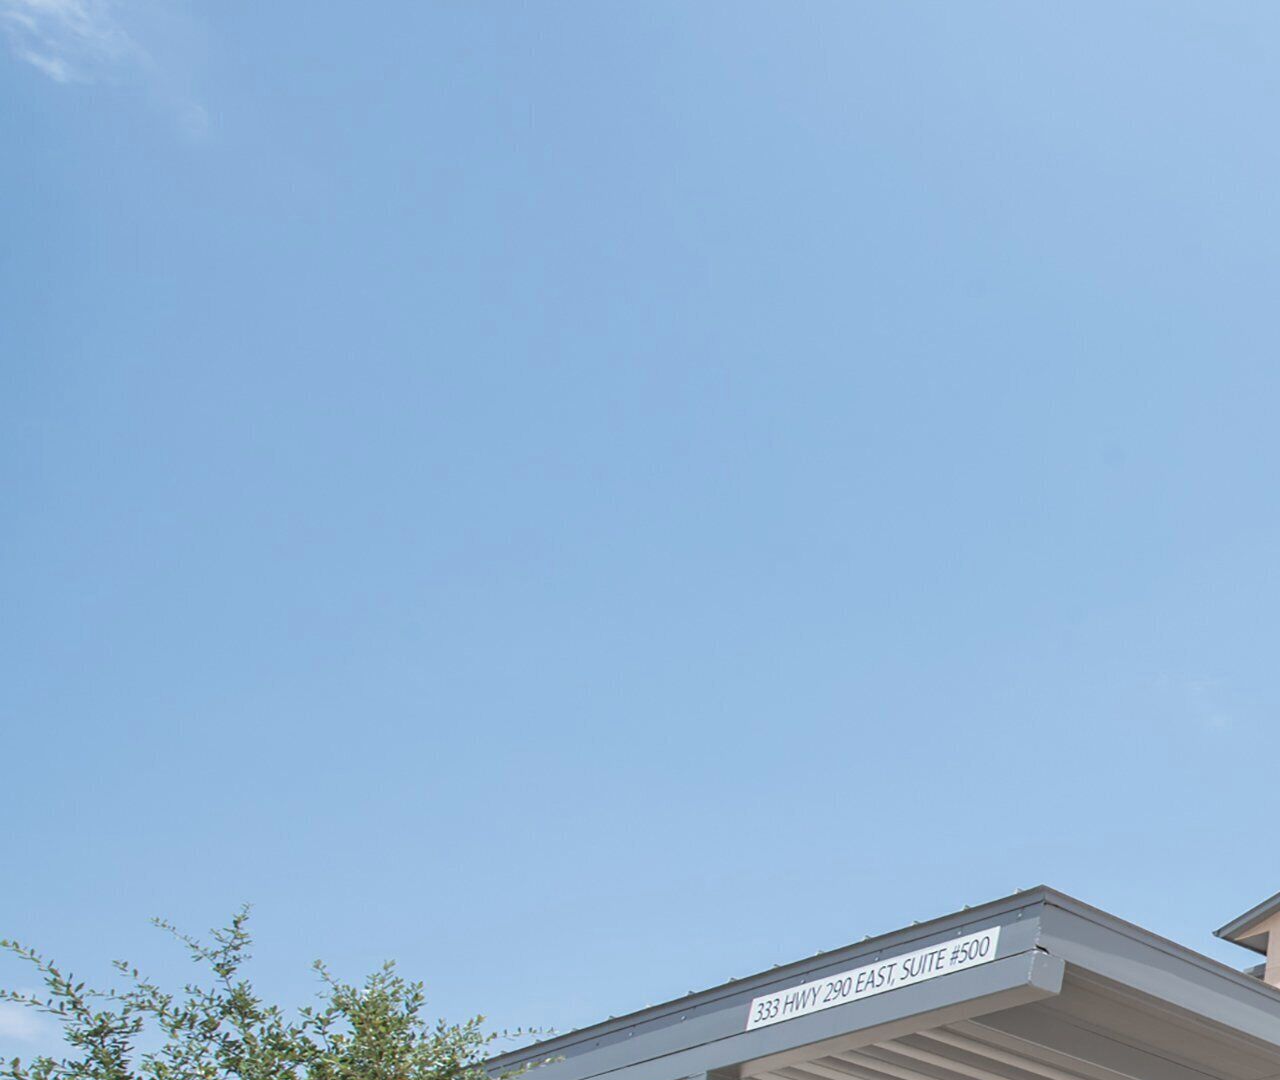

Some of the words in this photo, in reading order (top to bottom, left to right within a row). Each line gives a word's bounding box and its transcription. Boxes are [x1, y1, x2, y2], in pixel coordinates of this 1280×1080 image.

[754, 999, 781, 1023] 333
[782, 986, 824, 1014] HWY
[823, 977, 852, 1003] 290
[855, 963, 896, 993] EAST,
[900, 948, 947, 980] SUITE
[949, 936, 990, 966] #500
